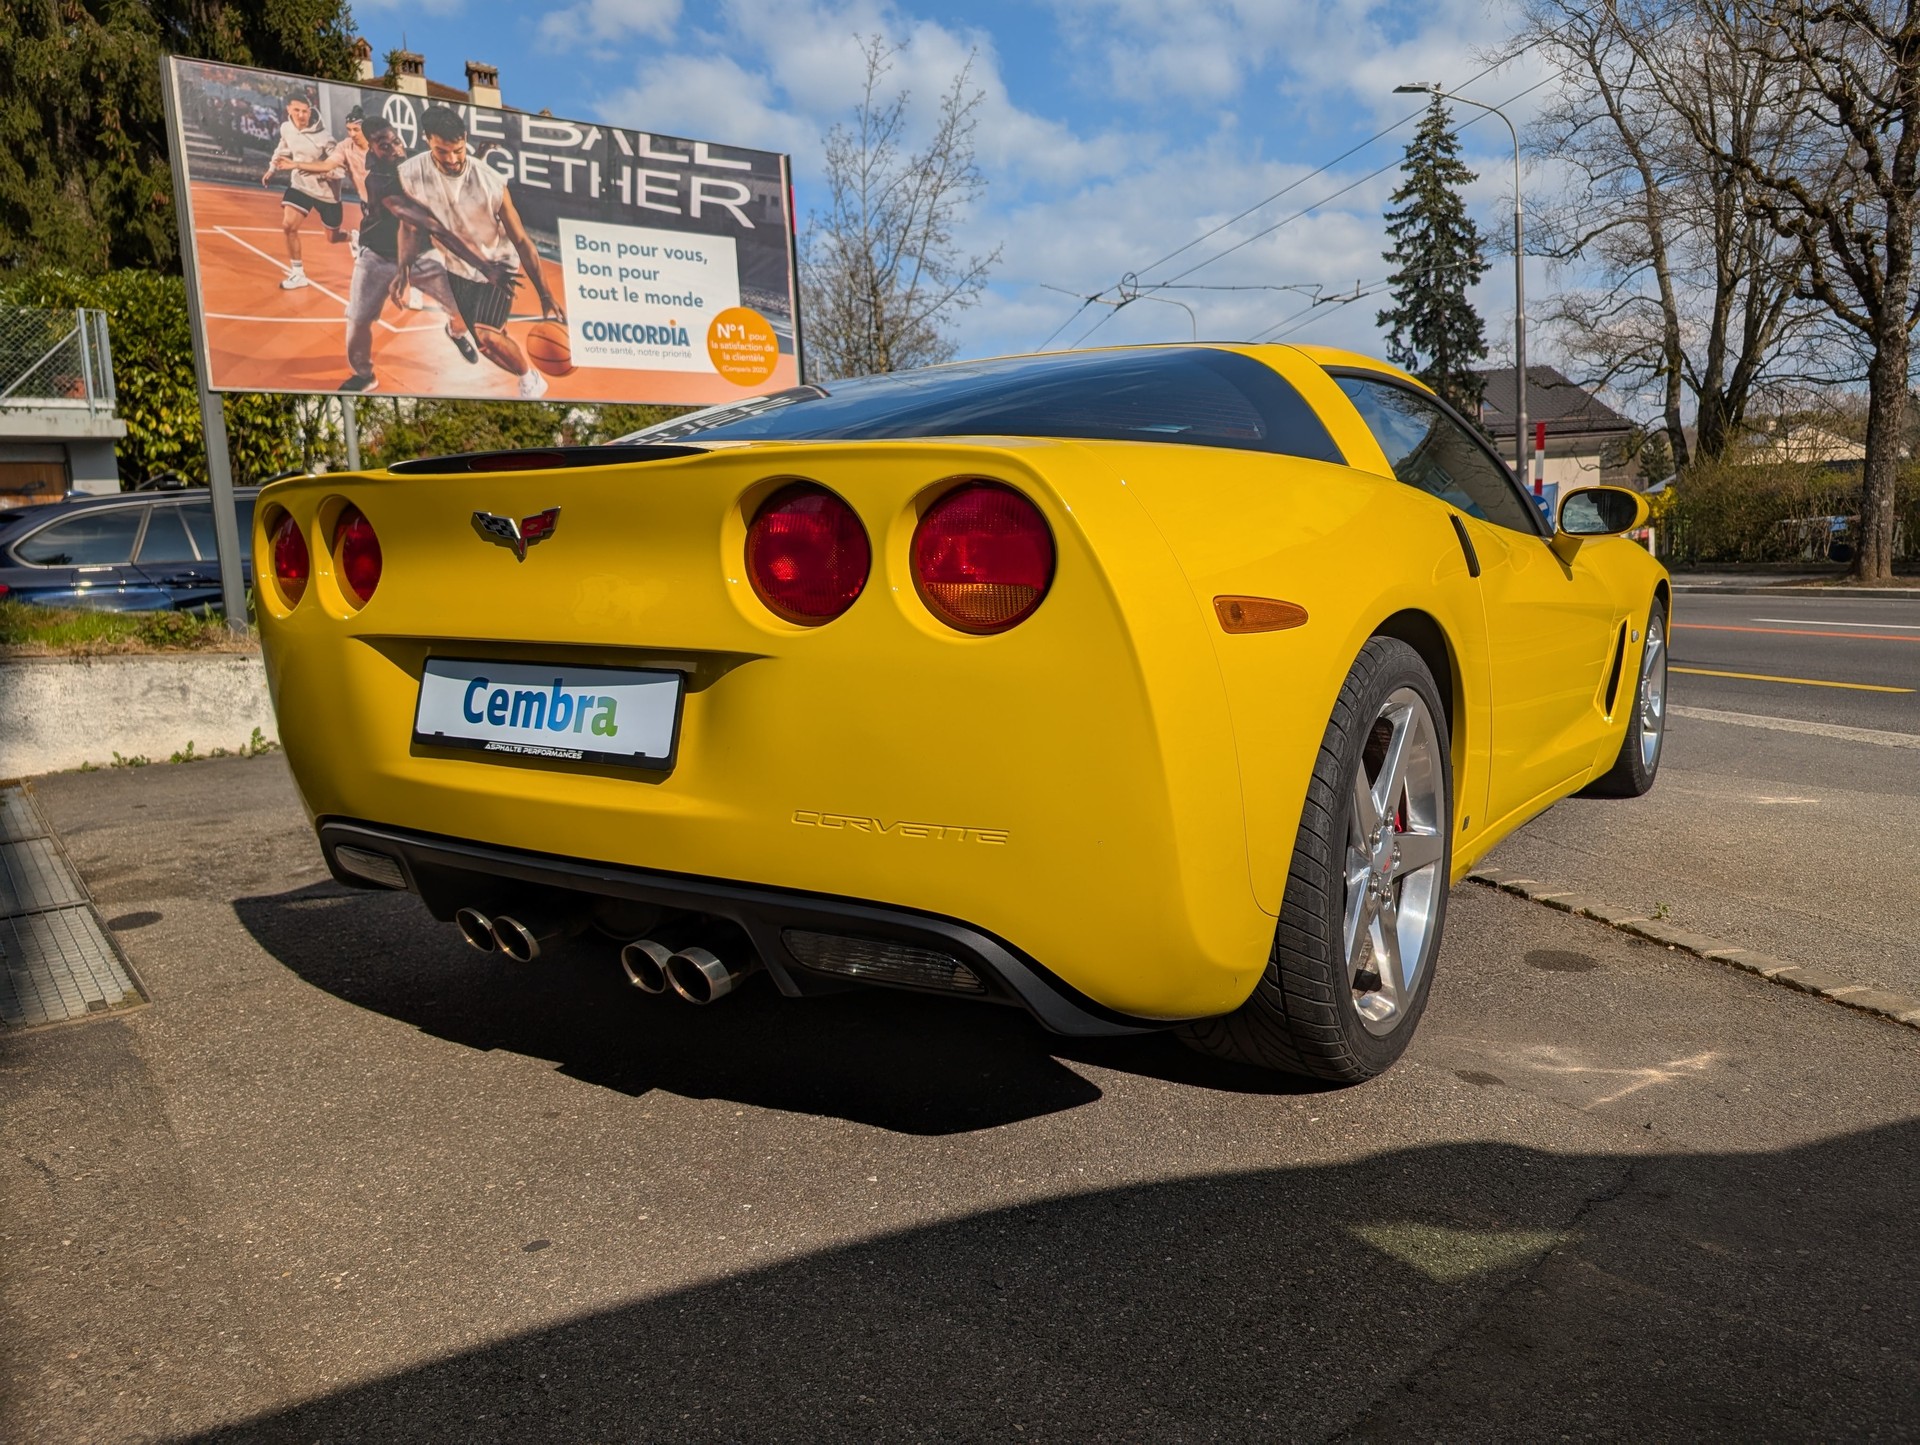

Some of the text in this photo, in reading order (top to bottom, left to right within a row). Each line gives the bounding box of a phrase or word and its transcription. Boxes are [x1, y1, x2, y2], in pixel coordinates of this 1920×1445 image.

[575, 234, 708, 265] Bon pour vous,
[577, 257, 660, 282] bon pour
[579, 284, 704, 308] tout le monde
[711, 340, 775, 353] la satisfaction de
[749, 333, 767, 342] pour
[585, 345, 692, 360] votre santé, notre priorité
[722, 352, 730, 361] la
[463, 676, 618, 737] Cembra
[485, 743, 583, 760] ASPHALTE PERFORMANCES
[791, 810, 1010, 845] CORVETTE
